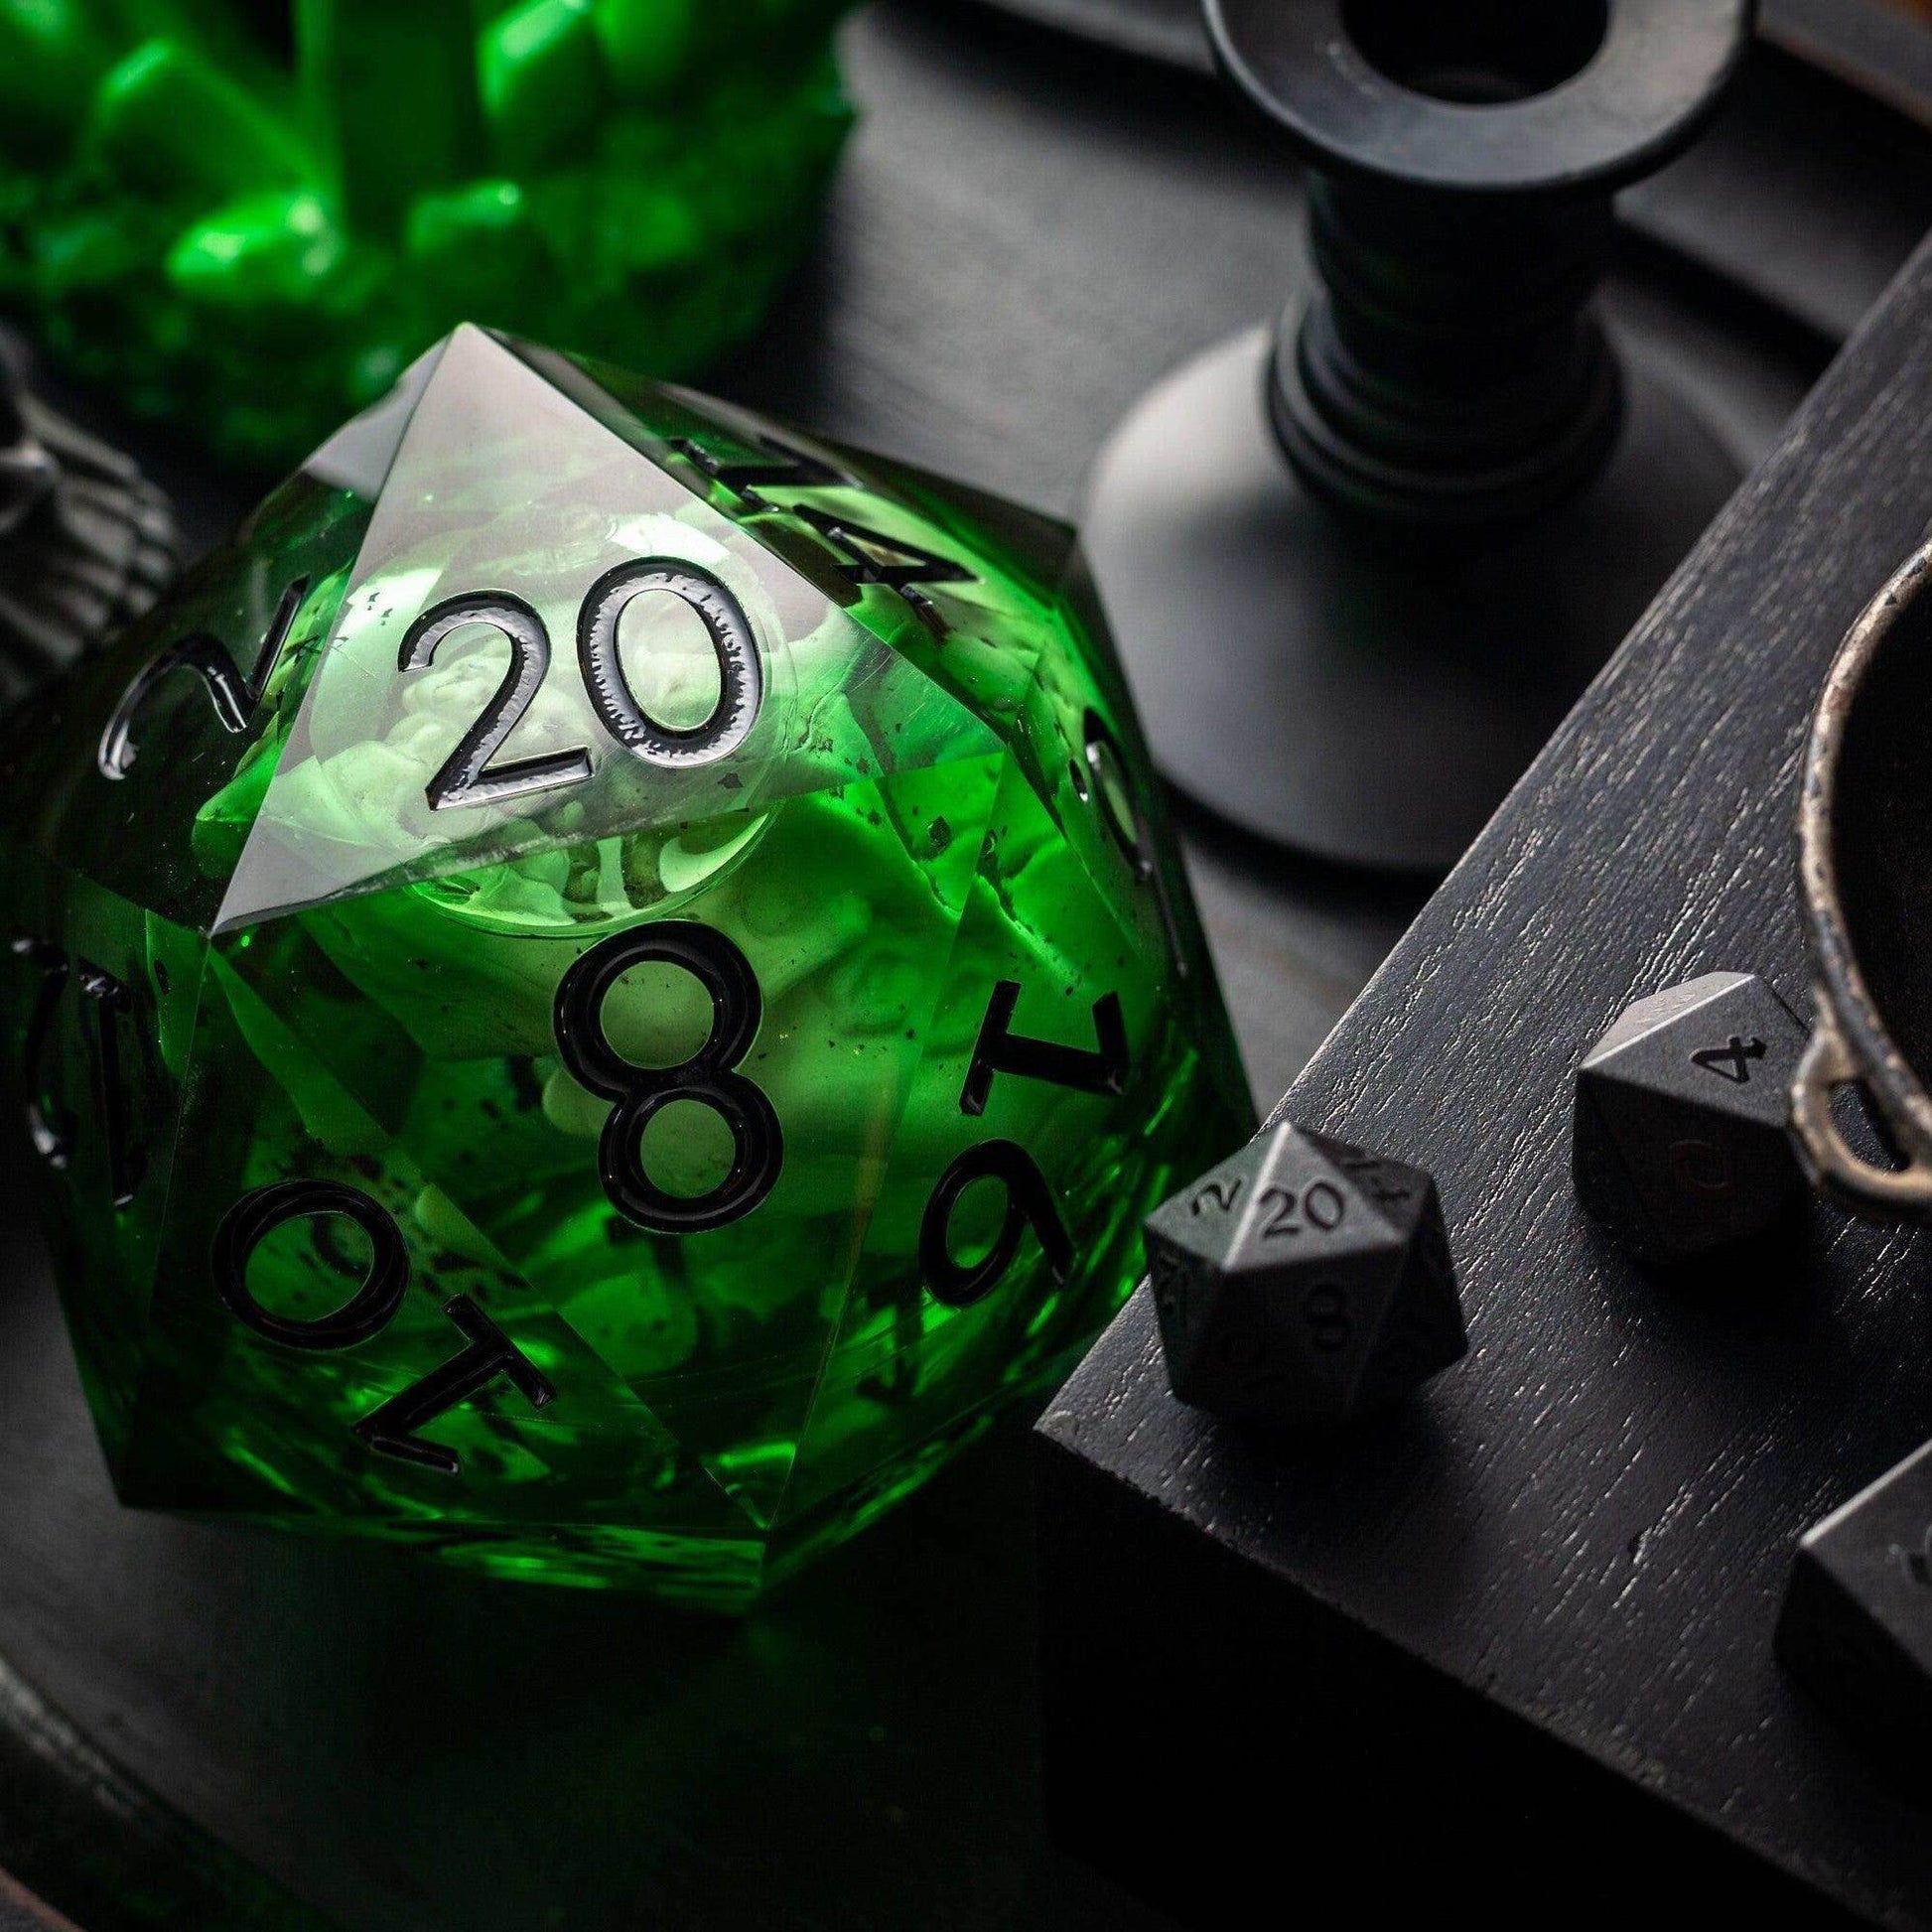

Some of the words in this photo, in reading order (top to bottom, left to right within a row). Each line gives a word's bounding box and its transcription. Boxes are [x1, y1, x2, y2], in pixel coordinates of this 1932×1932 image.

[98, 574, 308, 780] 2
[398, 556, 762, 810] 20
[553, 919, 783, 1234] 8
[1690, 1036, 1767, 1084] 4
[1193, 1178, 1241, 1216] 2
[1258, 1181, 1344, 1238] 20
[210, 1177, 557, 1474] 10
[1304, 1283, 1350, 1351] 8
